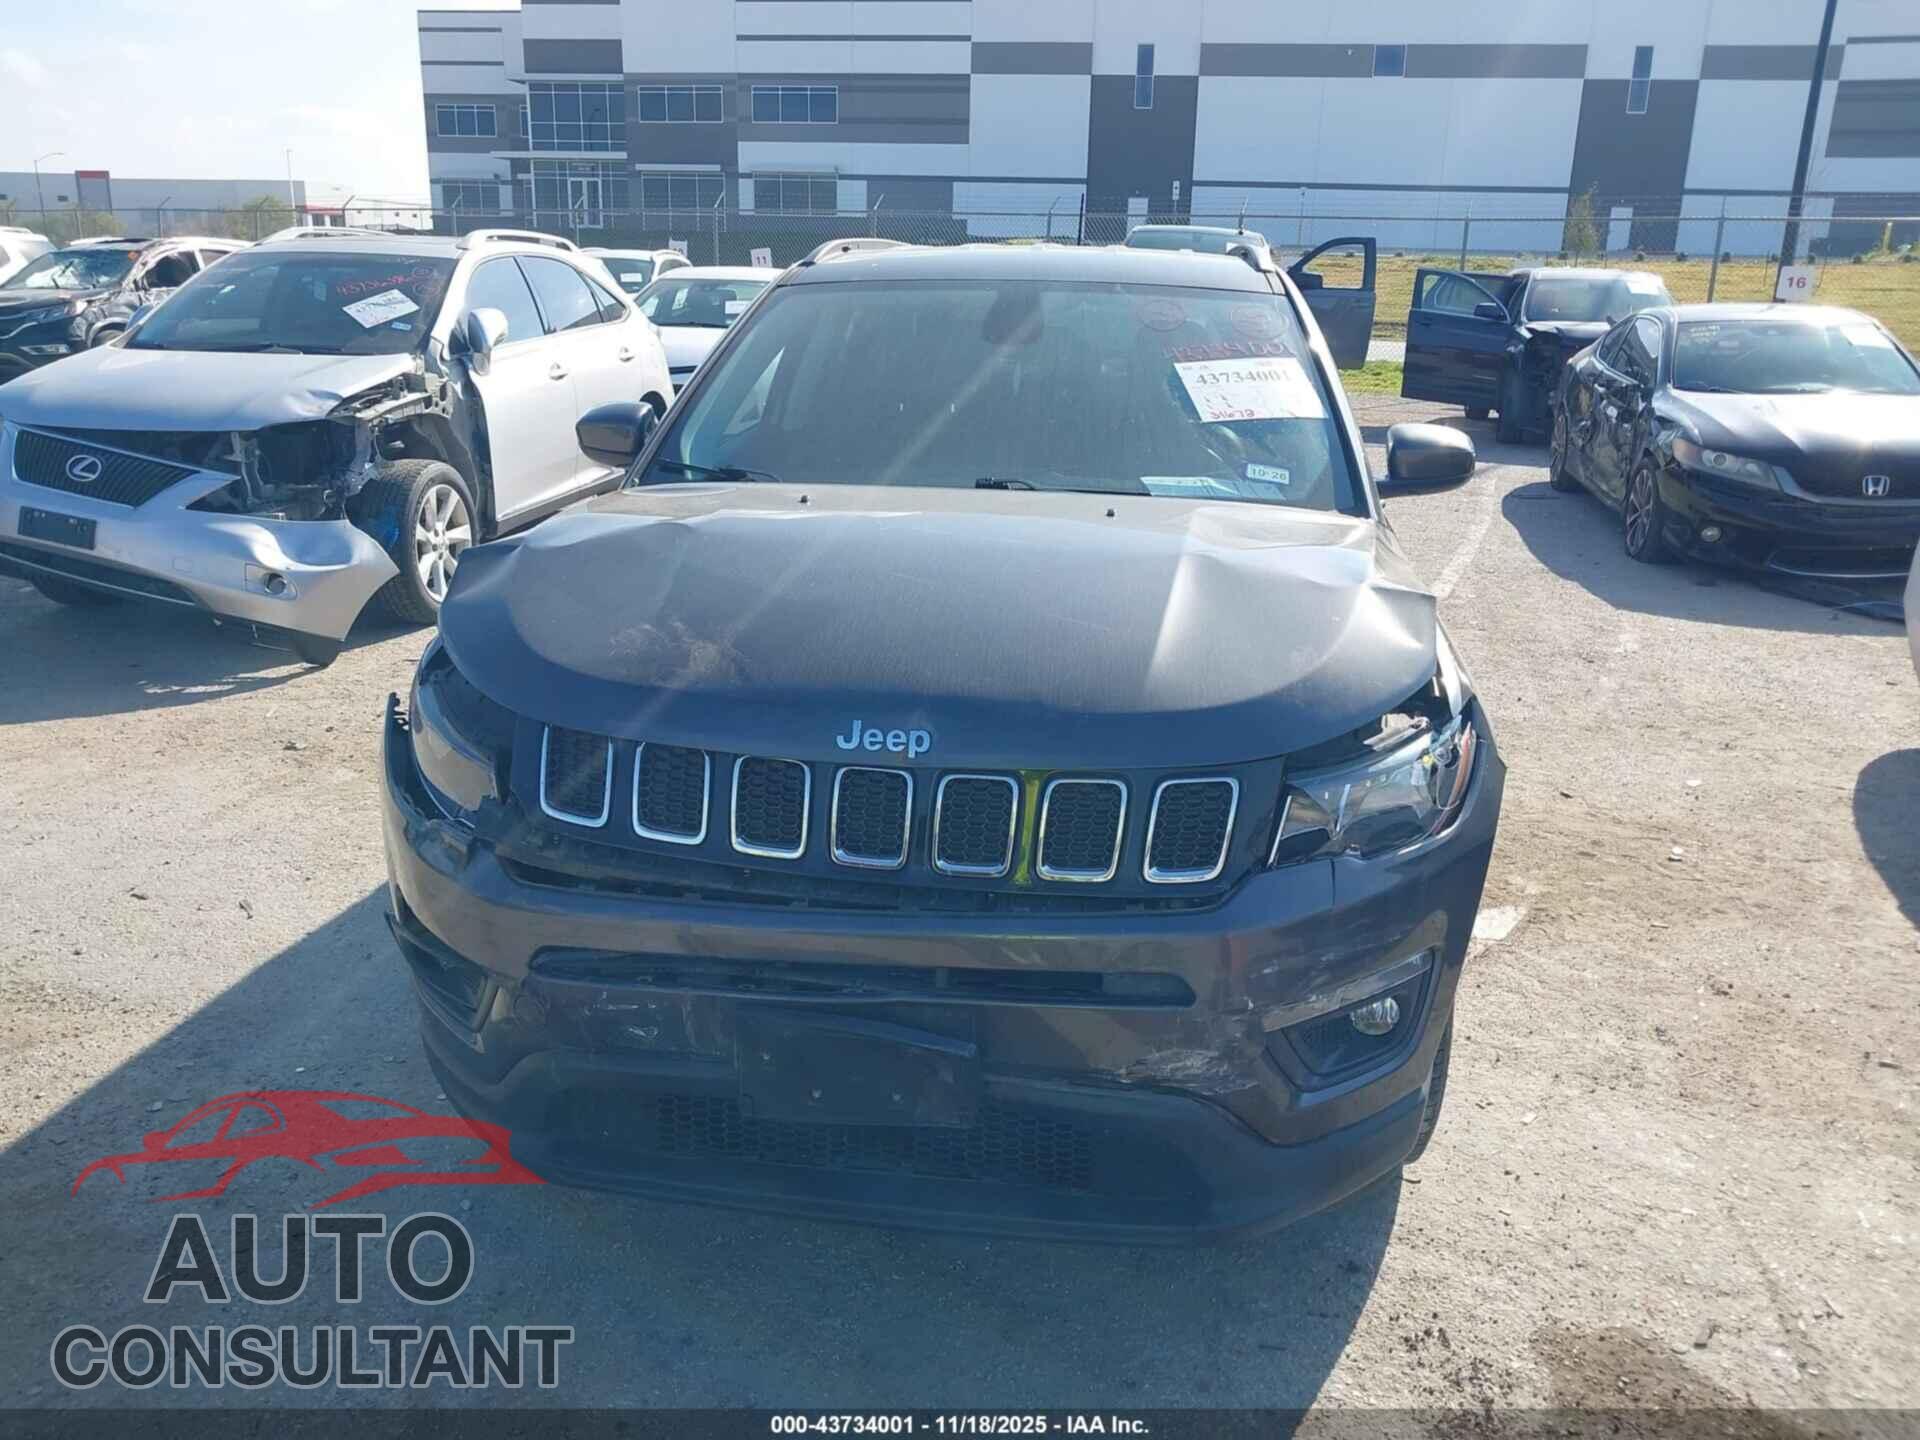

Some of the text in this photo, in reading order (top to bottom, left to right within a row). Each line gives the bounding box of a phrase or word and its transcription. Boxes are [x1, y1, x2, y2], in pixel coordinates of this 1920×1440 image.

[1786, 276, 1807, 289] 16
[1195, 368, 1293, 386] 43734001
[836, 719, 932, 759] Jeep
